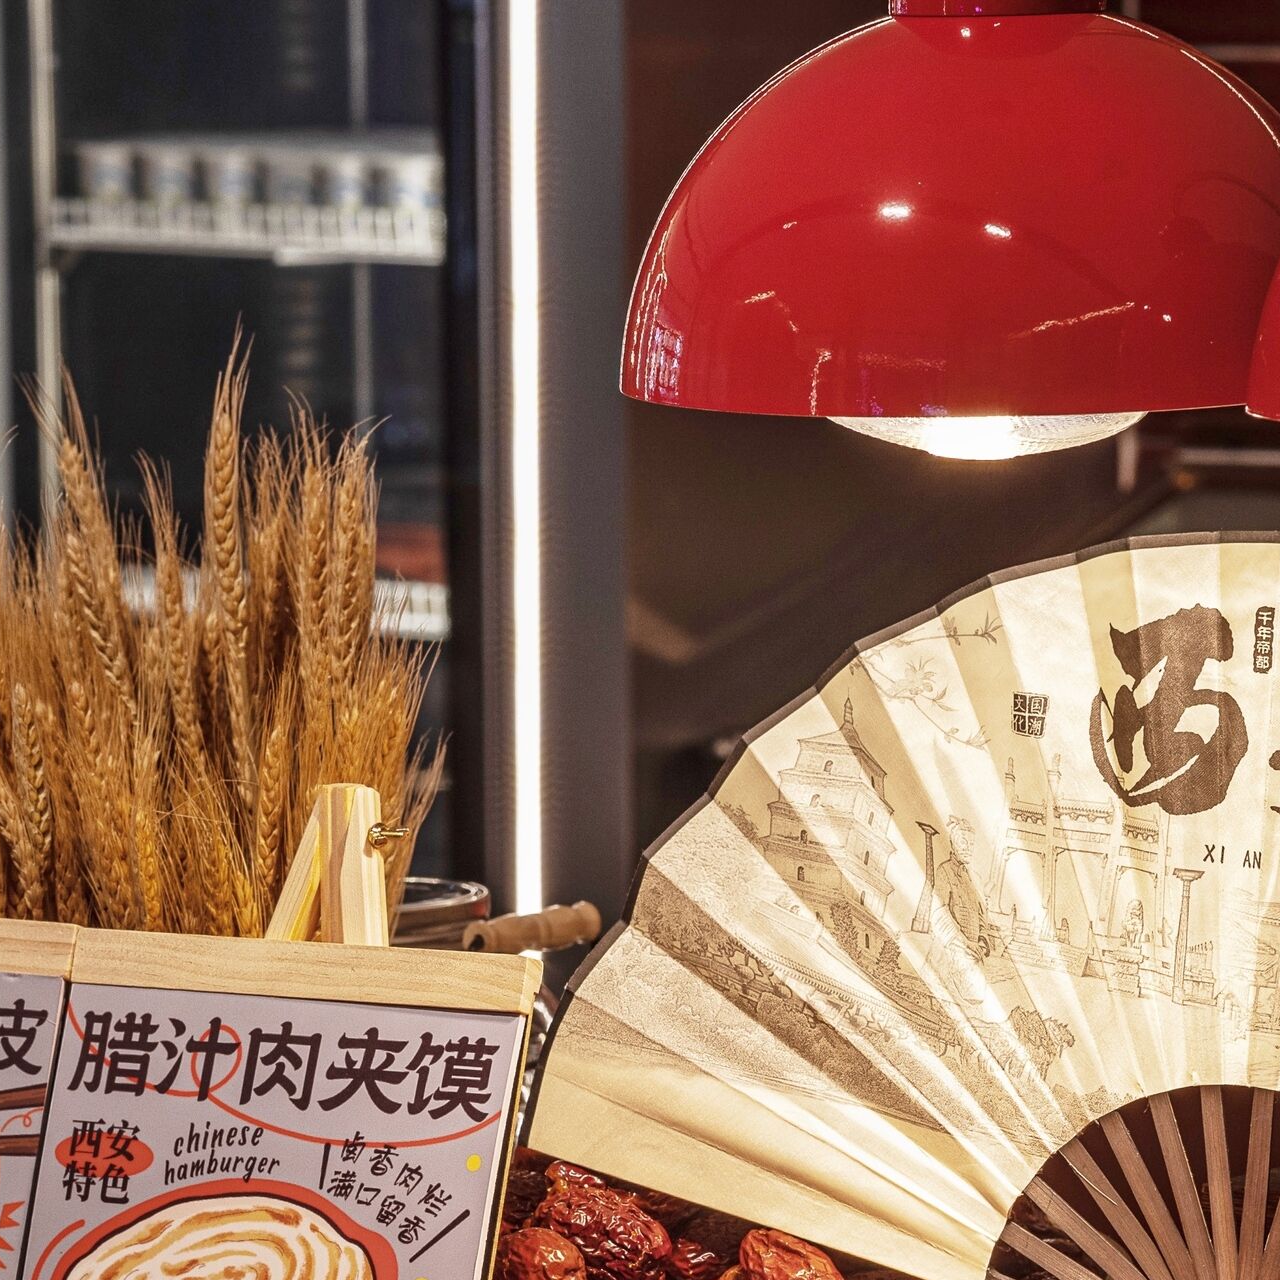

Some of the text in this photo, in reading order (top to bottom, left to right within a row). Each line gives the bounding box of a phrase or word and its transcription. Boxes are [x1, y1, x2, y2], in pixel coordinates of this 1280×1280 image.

[1256, 611, 1273, 670] 千年帝都
[1203, 845, 1262, 869] XI AN
[67, 1009, 501, 1122] 腊汁肉夹馍
[68, 1118, 140, 1162] 西安
[173, 1120, 265, 1157] chinese
[62, 1159, 131, 1205] 特色
[164, 1149, 281, 1186] hamburger
[327, 1169, 426, 1244] 满口留香
